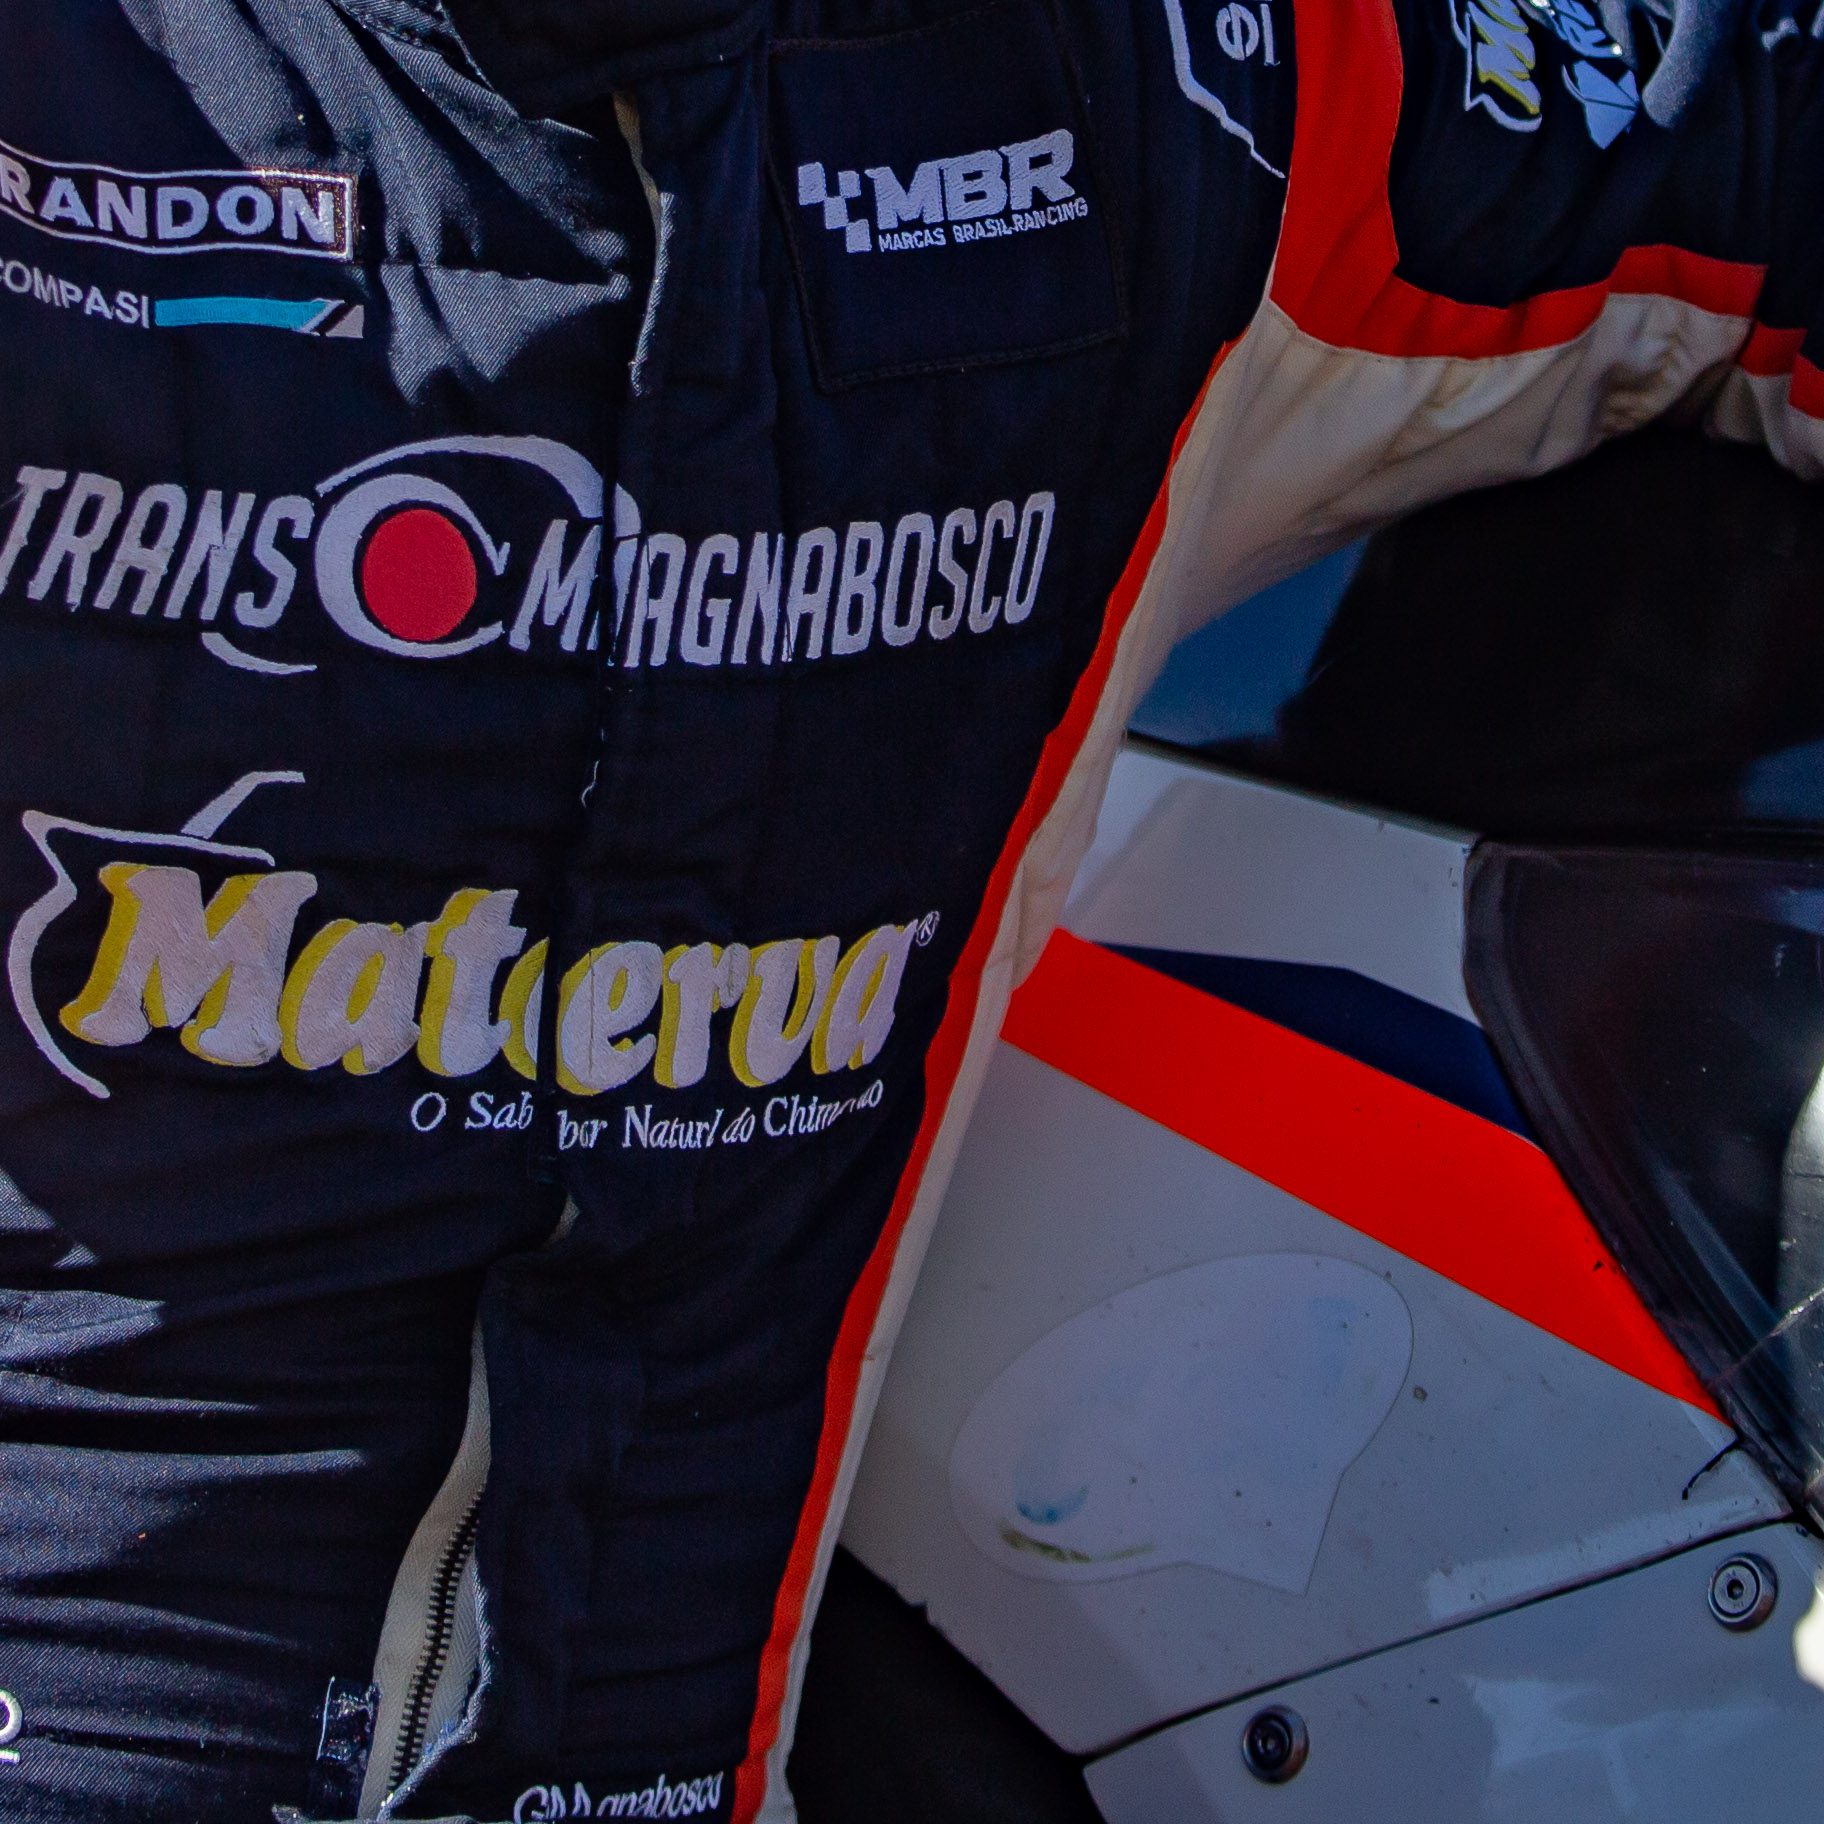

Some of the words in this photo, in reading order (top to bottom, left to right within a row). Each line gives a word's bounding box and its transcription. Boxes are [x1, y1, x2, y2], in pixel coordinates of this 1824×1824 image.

[864, 128, 1076, 230] MBR
[878, 227, 947, 253] MARCAS
[508, 490, 1056, 667] MAGNABOSCO
[410, 1091, 447, 1132] O
